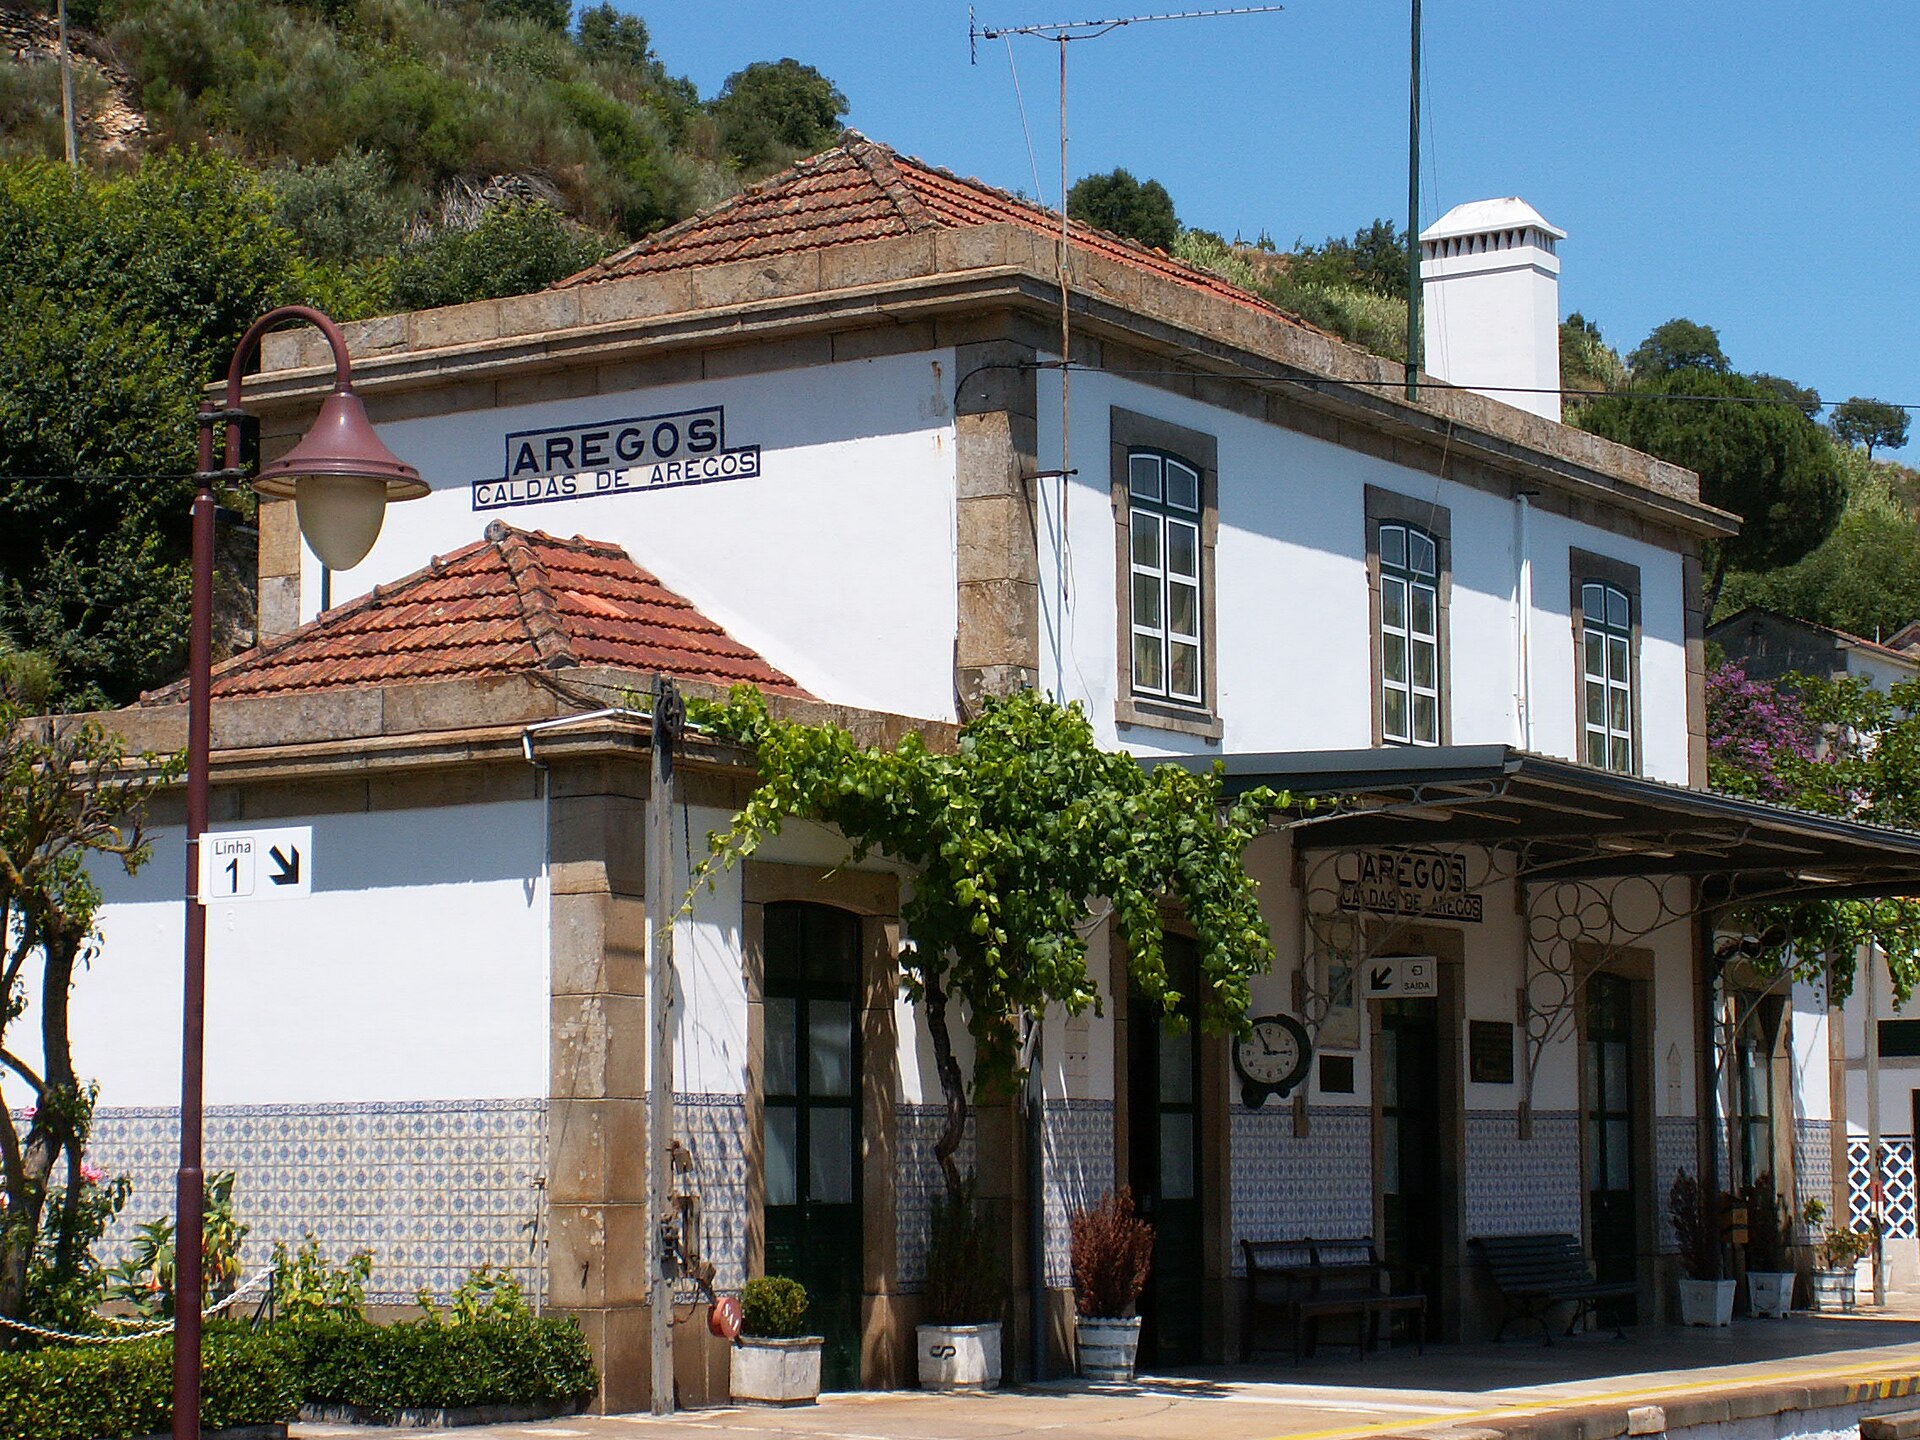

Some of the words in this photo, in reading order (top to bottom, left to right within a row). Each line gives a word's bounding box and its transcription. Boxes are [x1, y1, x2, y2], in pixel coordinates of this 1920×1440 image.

[513, 418, 718, 476] AREGOS
[476, 474, 577, 504] CALDAS
[596, 468, 629, 490] DE
[650, 452, 756, 484] AREGOS
[215, 840, 251, 855] Linha
[226, 857, 238, 893] 1
